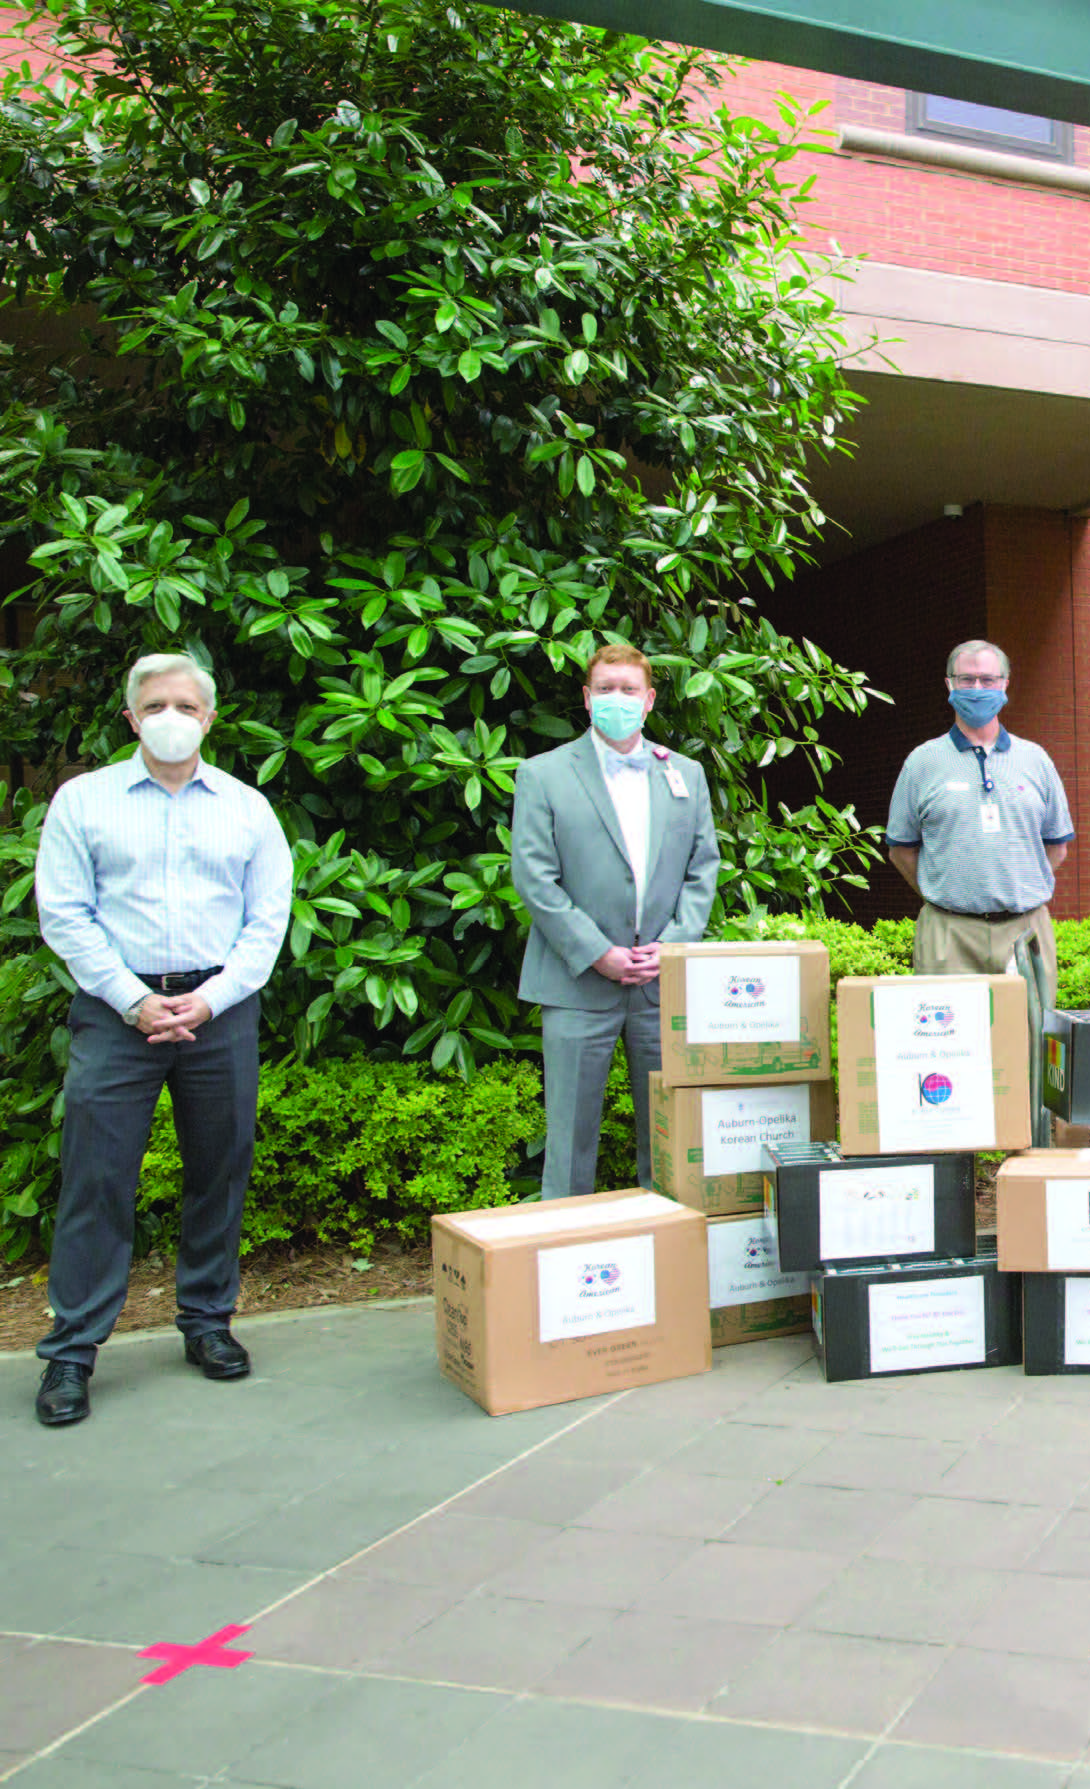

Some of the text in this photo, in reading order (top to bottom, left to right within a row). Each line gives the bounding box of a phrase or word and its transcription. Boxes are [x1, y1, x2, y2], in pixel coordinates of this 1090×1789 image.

[1049, 1064, 1065, 1092] KIND
[718, 1113, 797, 1130] Auburn-Opelika
[720, 1130, 795, 1145] Korean Church
